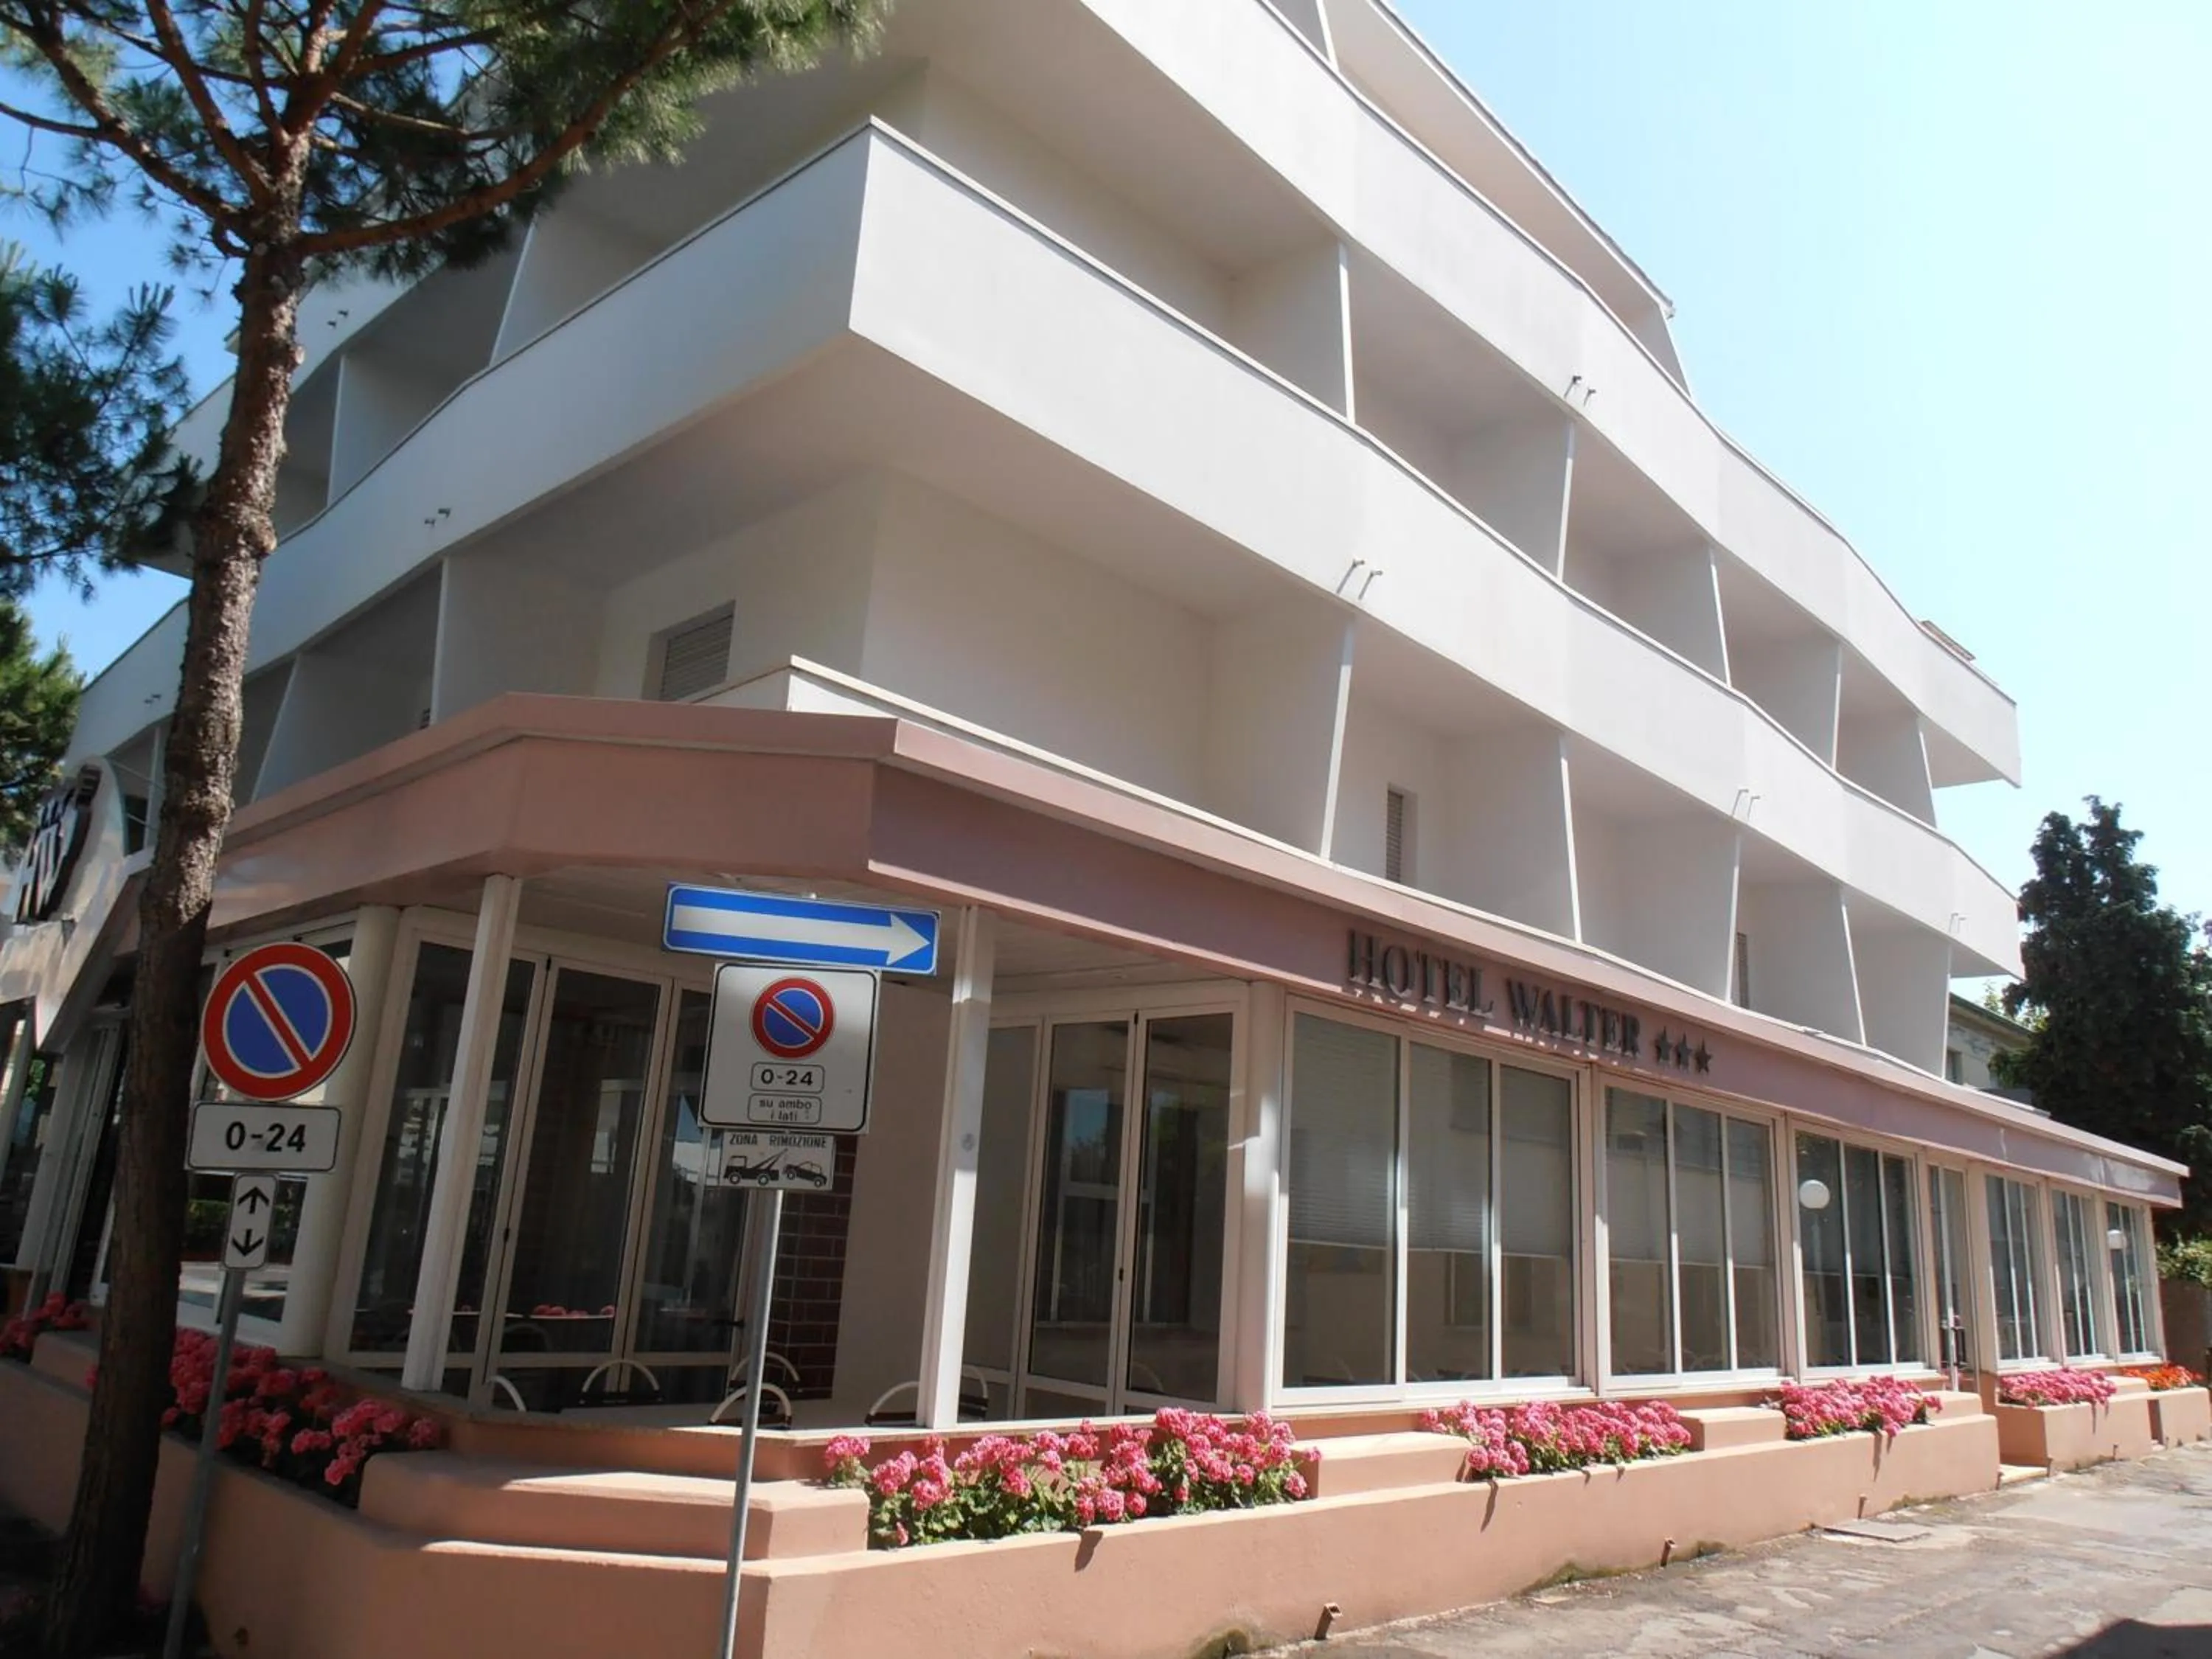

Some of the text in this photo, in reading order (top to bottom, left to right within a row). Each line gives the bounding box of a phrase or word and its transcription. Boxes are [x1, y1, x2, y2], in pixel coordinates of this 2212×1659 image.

[1348, 928, 1641, 1060] HOTEL WALTER
[760, 1068, 814, 1086] 0-24
[759, 1099, 812, 1110] su ambo
[779, 1110, 799, 1121] lati
[225, 1121, 307, 1153] 0-24
[729, 1133, 827, 1149] ZONA RIMOZIONE
